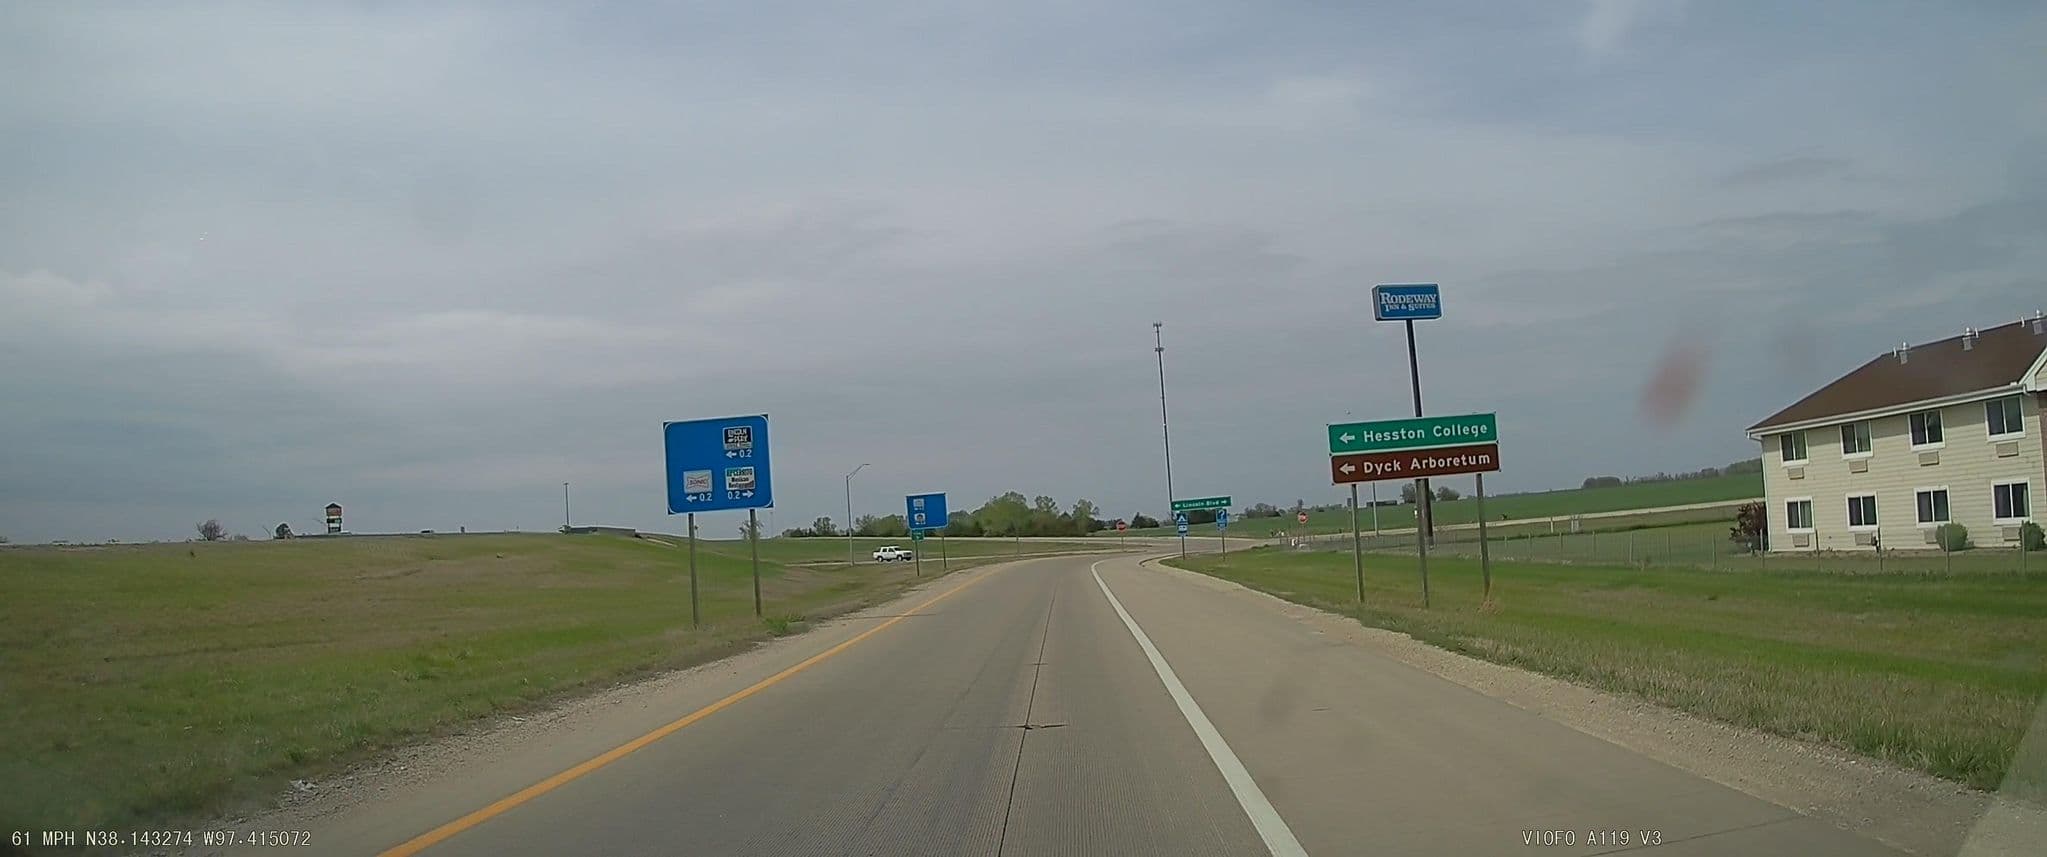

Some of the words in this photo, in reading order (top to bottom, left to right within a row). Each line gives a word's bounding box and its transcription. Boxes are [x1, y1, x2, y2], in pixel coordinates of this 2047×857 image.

[1379, 292, 1437, 304] RODEWAY
[1363, 428, 1425, 443] Hesston
[1433, 423, 1488, 438] College
[739, 449, 752, 458] 0.2
[1363, 460, 1402, 475] Dyck
[1410, 454, 1490, 470] Arboretum
[699, 493, 713, 502] 0.2
[727, 491, 741, 500] 0.2
